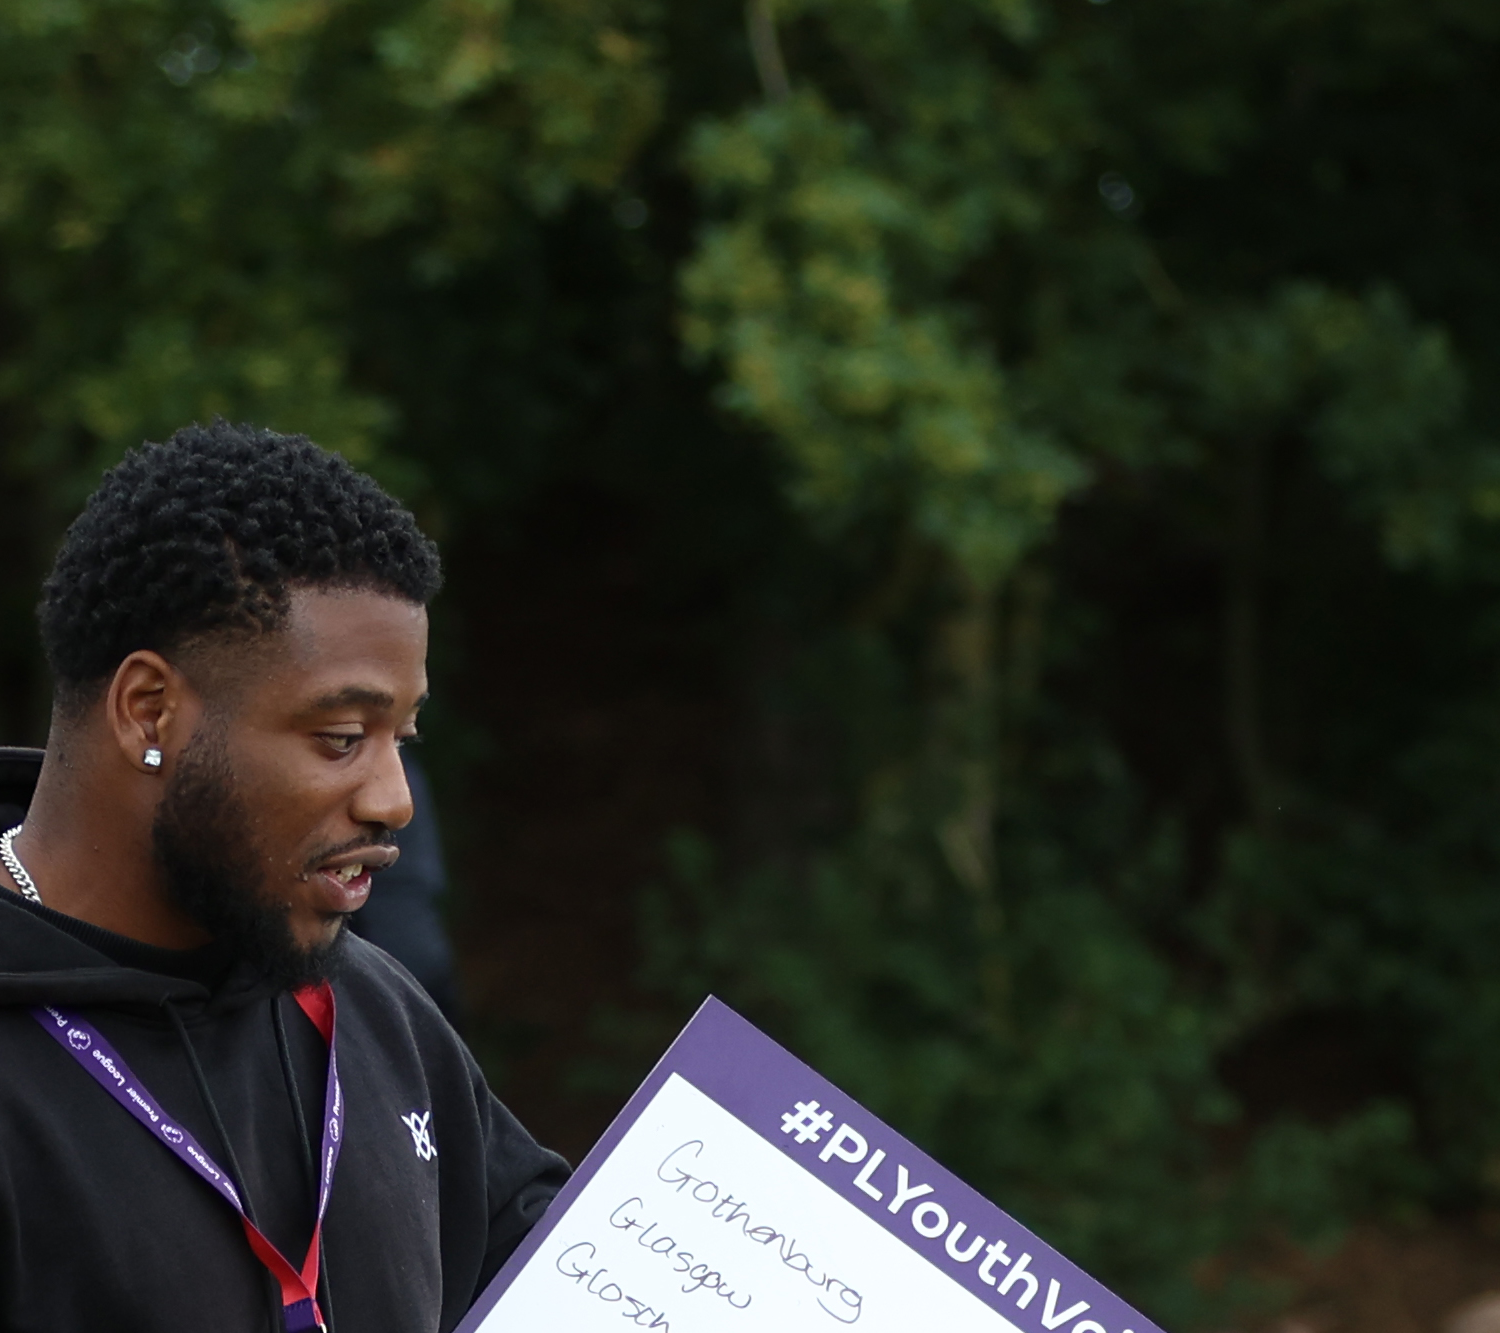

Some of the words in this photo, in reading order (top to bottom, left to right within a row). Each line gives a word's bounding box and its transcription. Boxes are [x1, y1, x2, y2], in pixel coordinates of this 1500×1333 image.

[92, 1049, 126, 1086] League
[126, 1088, 159, 1122] Premier
[609, 1197, 752, 1308] Glasgow
[657, 1140, 863, 1324] Gothenburg
